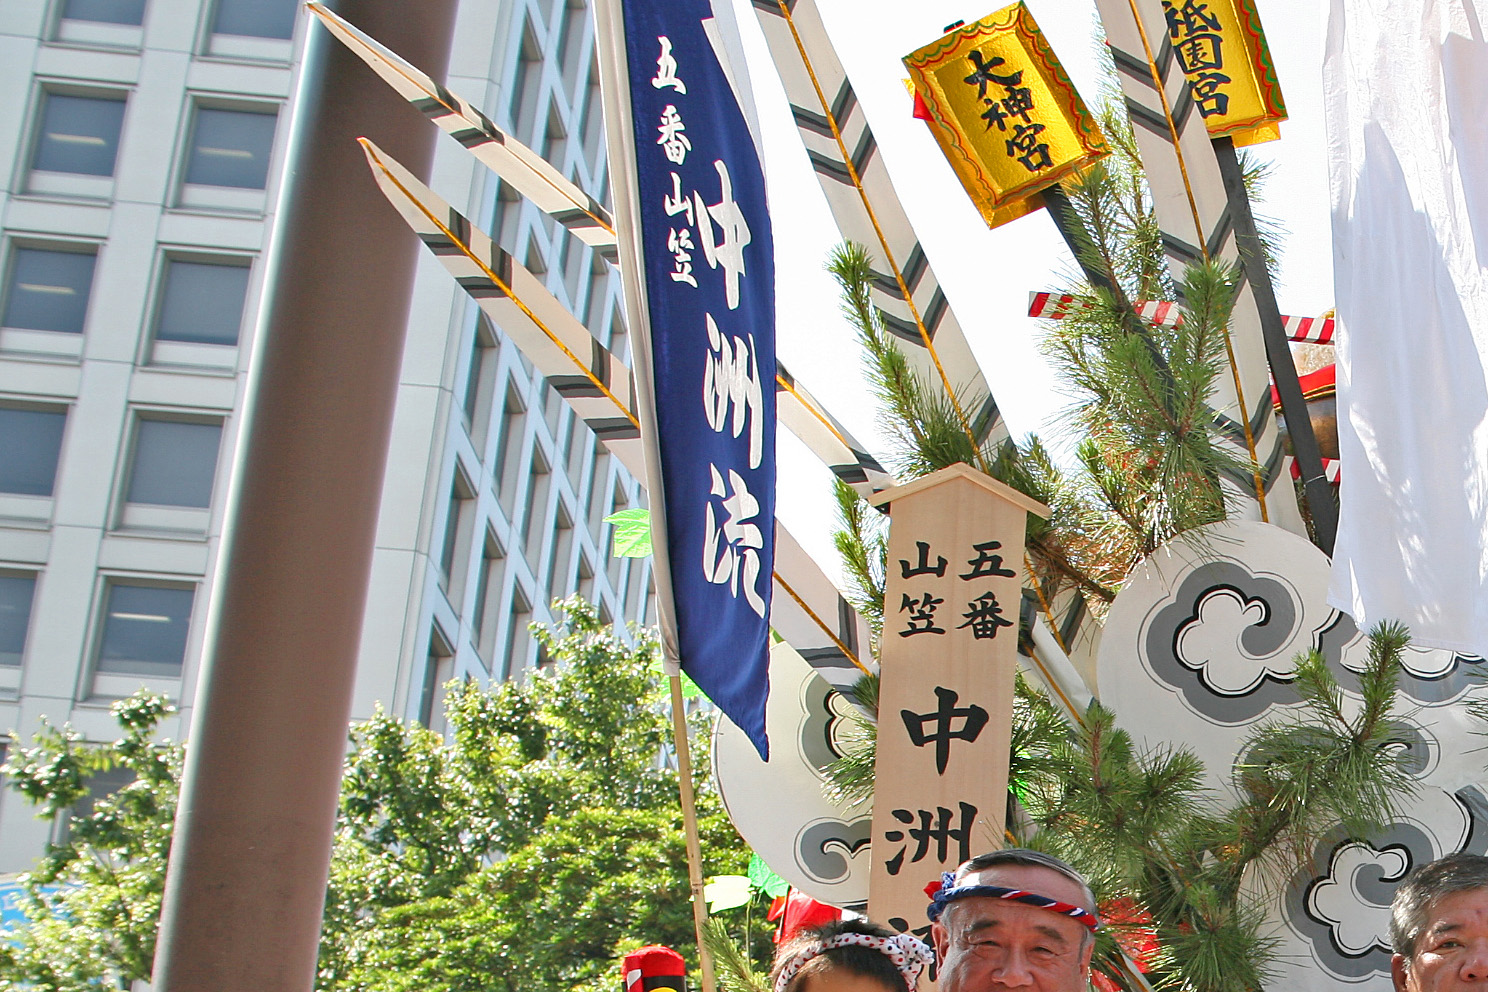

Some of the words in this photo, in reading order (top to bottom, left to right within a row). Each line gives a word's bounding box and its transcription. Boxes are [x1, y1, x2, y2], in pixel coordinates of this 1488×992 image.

[651, 35, 698, 289] 五番山笠
[964, 50, 1054, 172] 大神宮
[694, 159, 766, 619] 中洲流
[898, 540, 948, 638] 山笠
[955, 540, 1016, 640] 五番
[885, 685, 989, 945] 中洲
